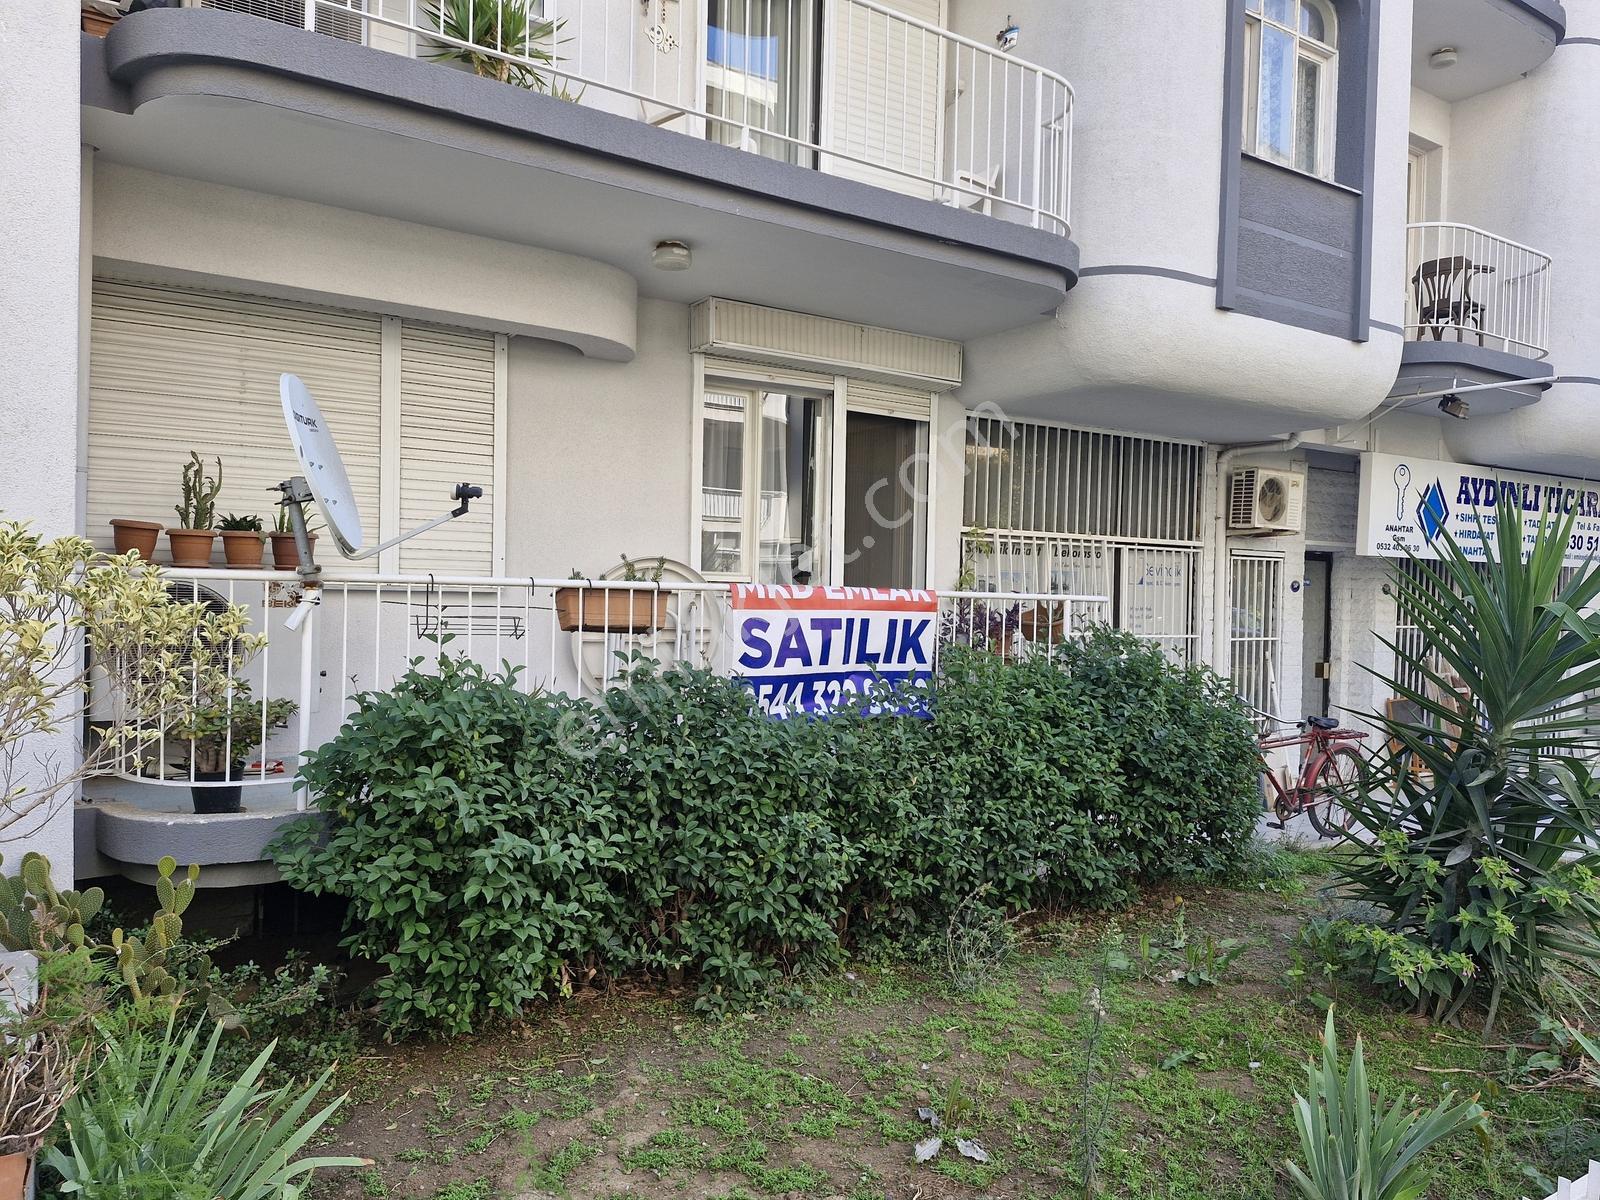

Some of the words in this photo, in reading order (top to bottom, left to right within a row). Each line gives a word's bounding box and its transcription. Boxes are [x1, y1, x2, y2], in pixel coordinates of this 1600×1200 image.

[1456, 476, 1541, 511] AYDINLI
[1544, 481, 1600, 518] TİCAR
[1385, 524, 1414, 533] ANAHTAR
[1577, 522, 1586, 531] Tel
[1587, 523, 1592, 531] &
[1458, 530, 1495, 541] HIRDAAT
[1566, 534, 1583, 550] 30
[739, 617, 931, 669] SATILIK
[744, 681, 805, 720] 544
